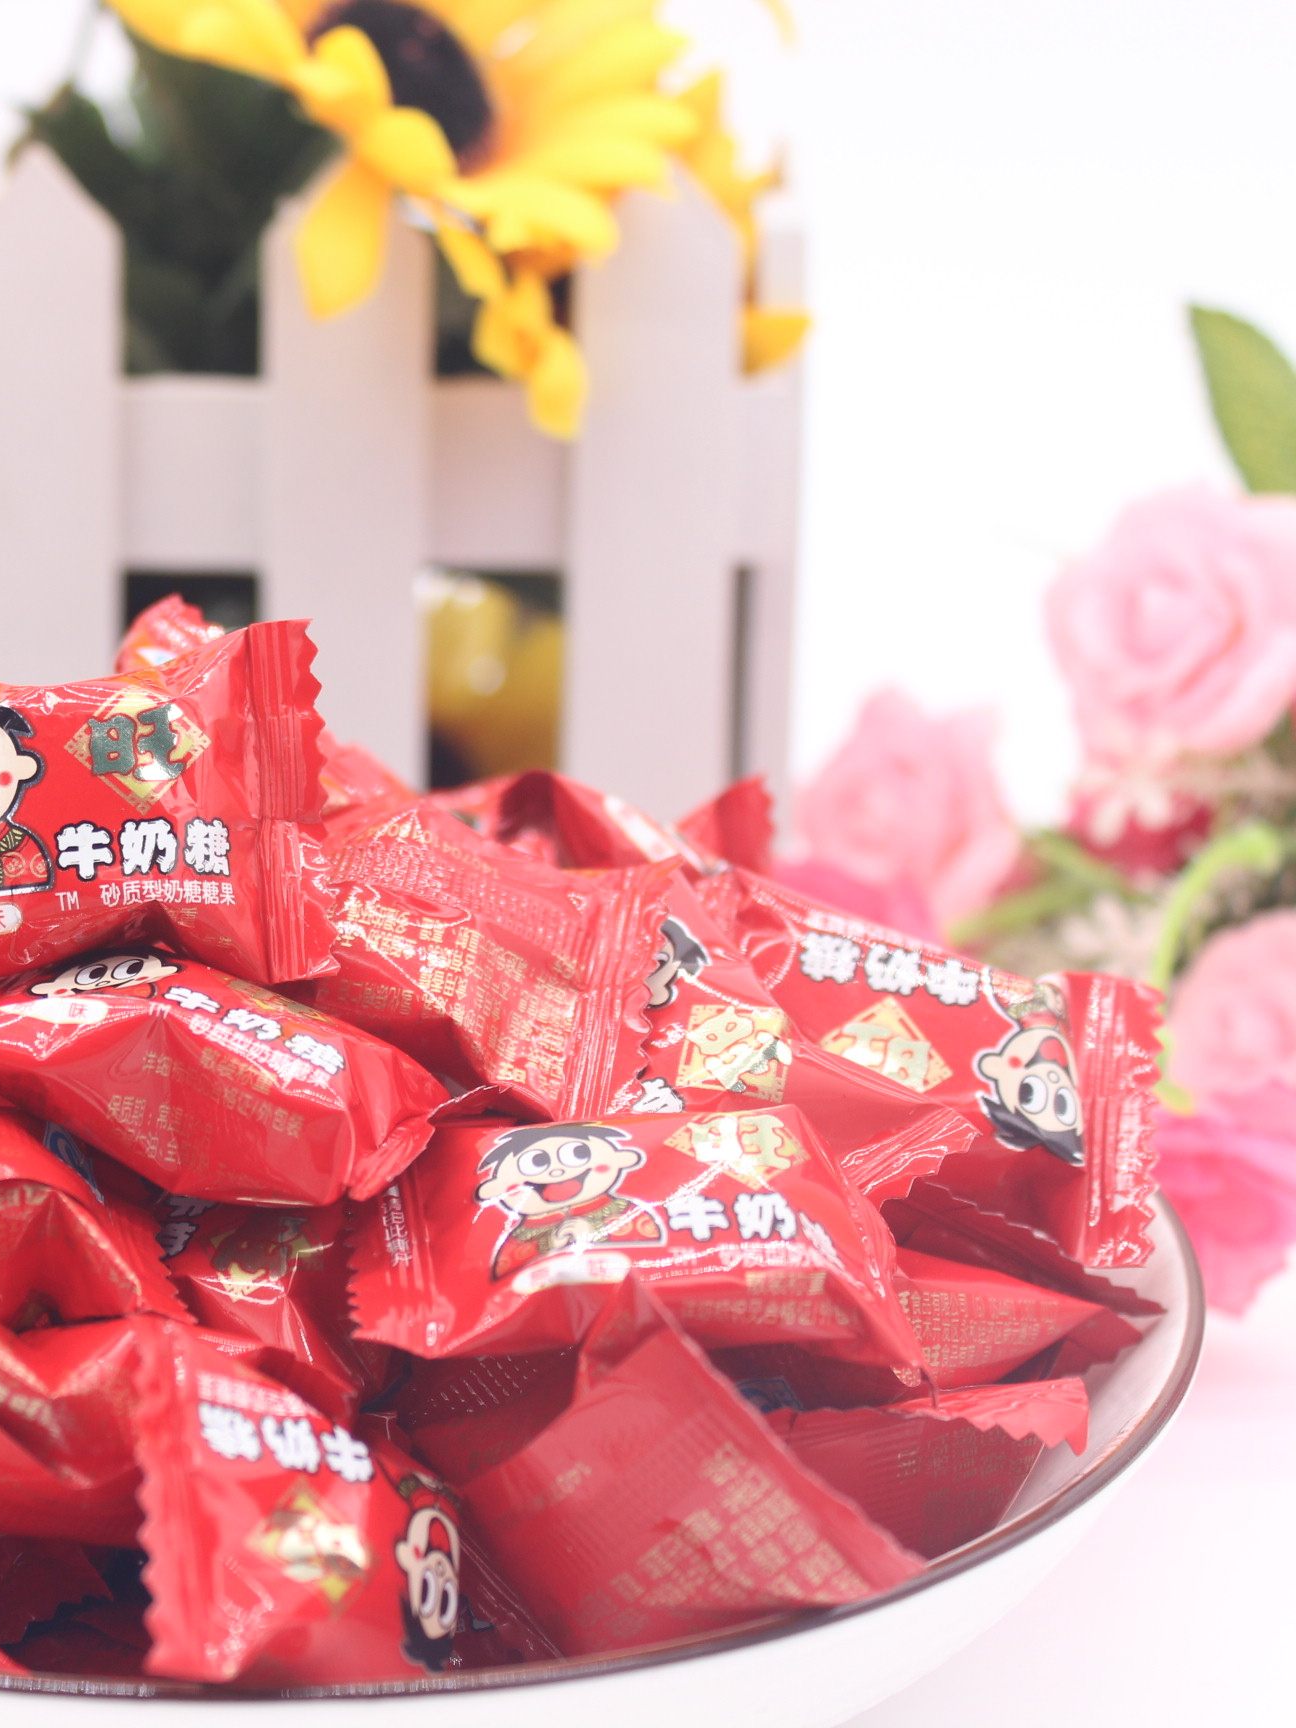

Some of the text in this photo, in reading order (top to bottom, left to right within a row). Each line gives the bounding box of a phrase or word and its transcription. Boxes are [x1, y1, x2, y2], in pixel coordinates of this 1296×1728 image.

[57, 818, 231, 881] 牛奶糖
[55, 892, 80, 912] TM
[99, 880, 236, 908] 砂质型奶糖糖果
[147, 1003, 172, 1018] TM
[163, 985, 347, 1076] 牛奶糖
